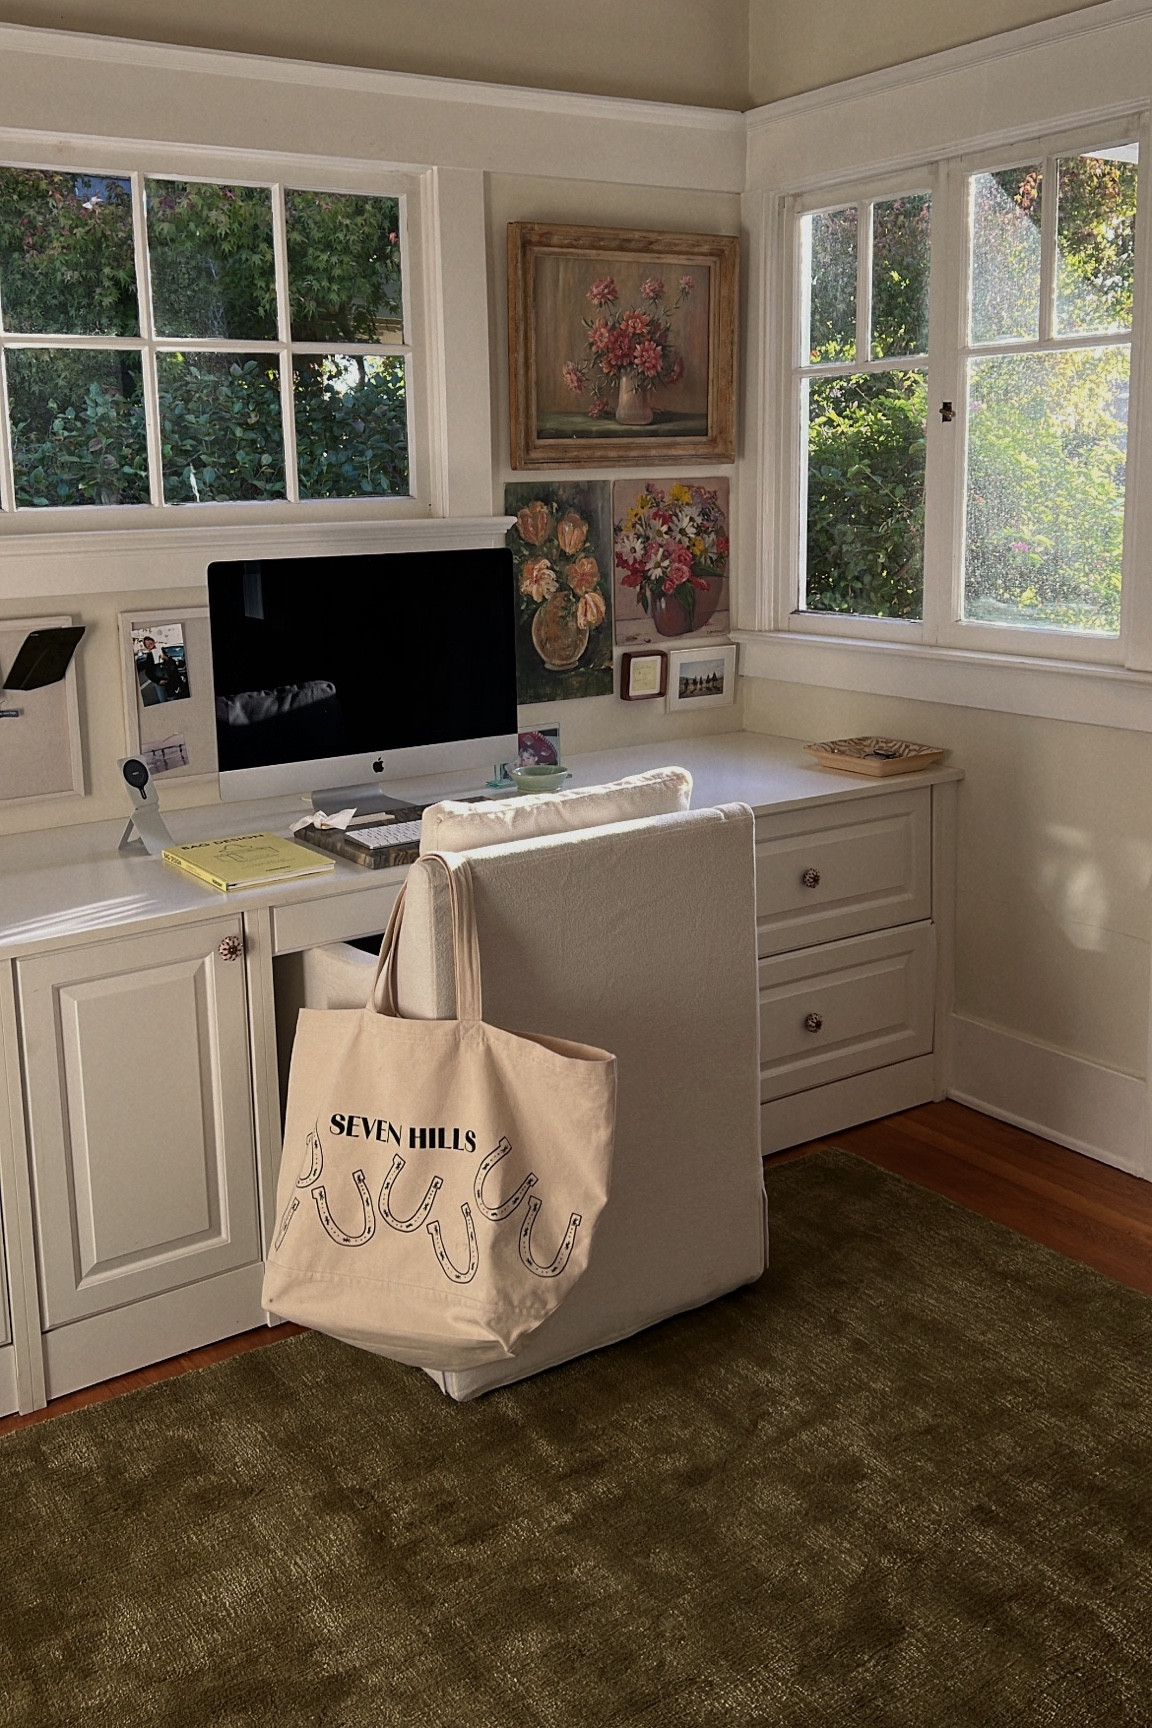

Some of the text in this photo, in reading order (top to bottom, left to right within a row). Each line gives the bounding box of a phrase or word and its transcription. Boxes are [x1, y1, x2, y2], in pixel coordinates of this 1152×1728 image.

[213, 834, 264, 844] DESIGN
[329, 1114, 477, 1153] SEVEN HILLS
